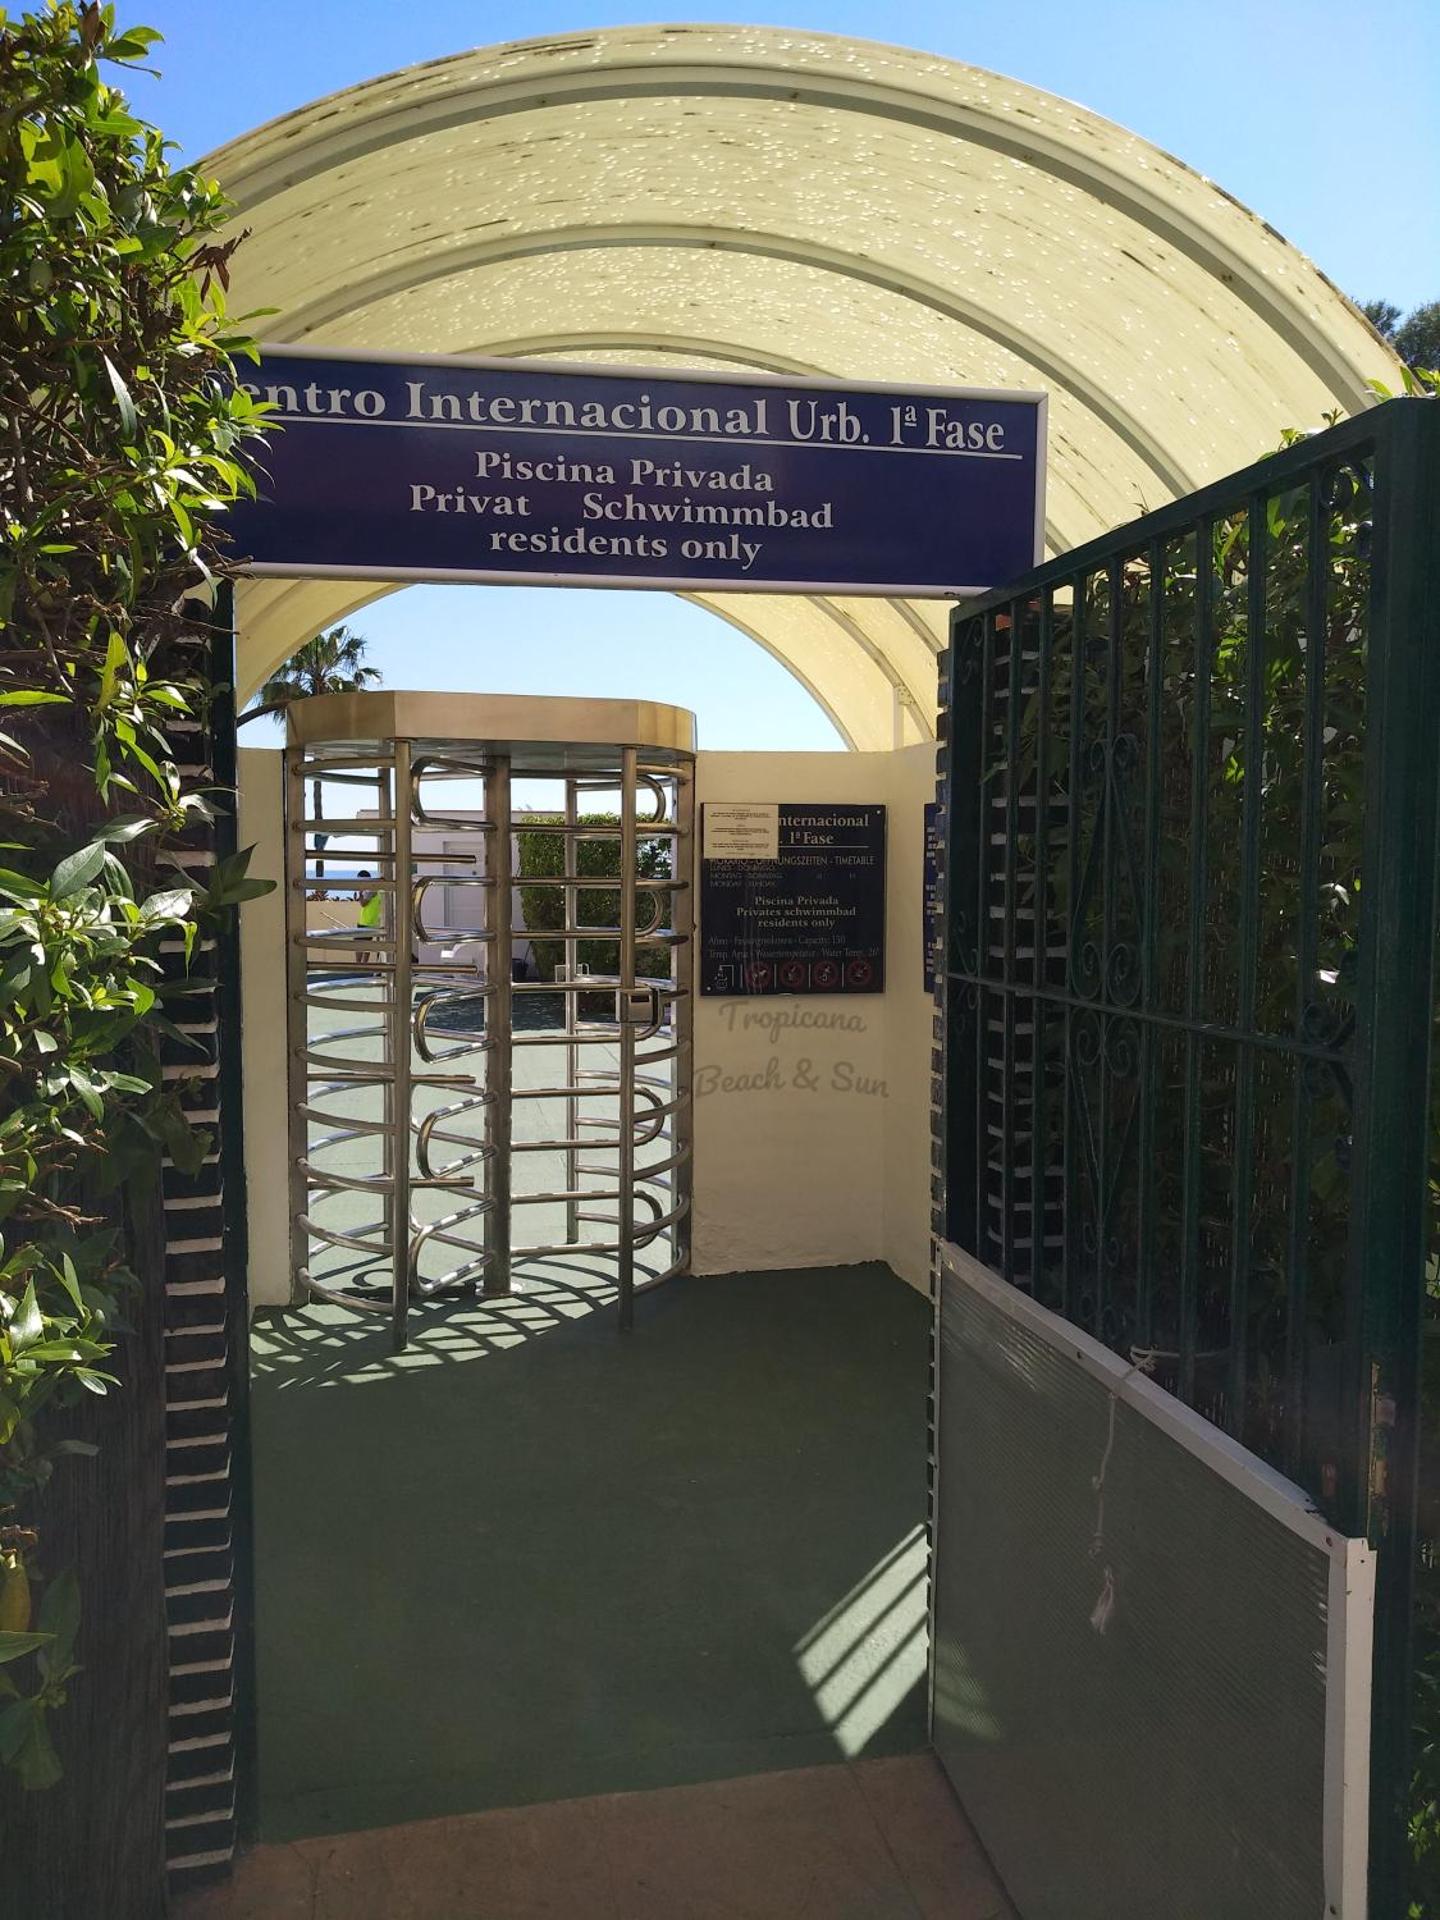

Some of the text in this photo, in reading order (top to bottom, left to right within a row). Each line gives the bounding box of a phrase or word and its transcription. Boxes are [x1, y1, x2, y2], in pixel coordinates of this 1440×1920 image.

[238, 382, 386, 417] ntro
[405, 382, 770, 435] Internacional
[786, 401, 870, 444] Urb.
[925, 408, 1004, 452] Fase
[475, 451, 773, 492] Piscina Privada
[409, 484, 833, 529] Privat Schwimmbad
[490, 527, 763, 571] residents only
[779, 813, 869, 827] nternacional
[803, 831, 835, 844] Fase
[834, 855, 876, 865] TIMETABLE
[755, 896, 839, 905] Piscina Privada
[736, 906, 856, 917] Privates schwimmbad
[758, 918, 835, 929] residents only
